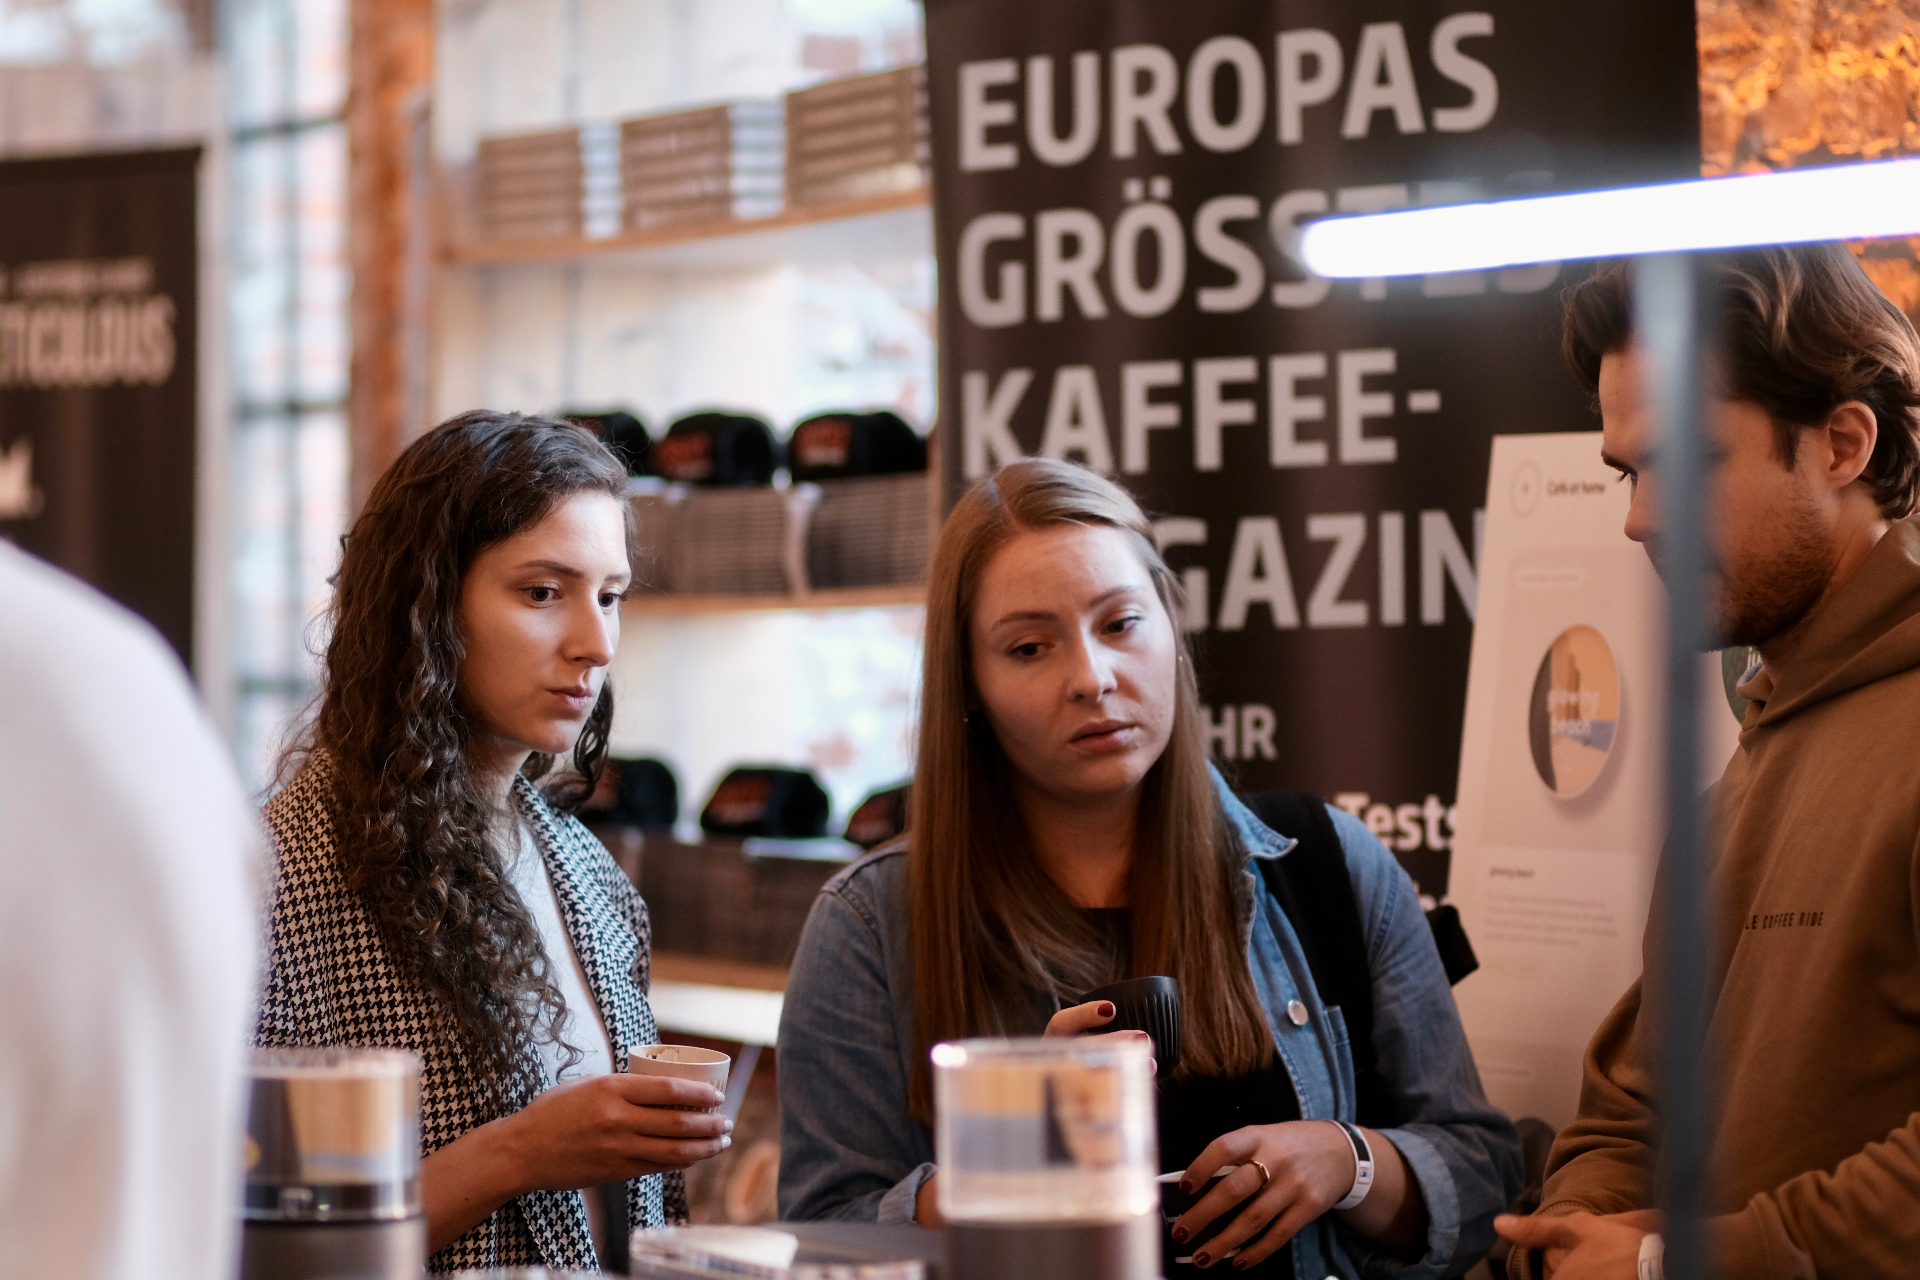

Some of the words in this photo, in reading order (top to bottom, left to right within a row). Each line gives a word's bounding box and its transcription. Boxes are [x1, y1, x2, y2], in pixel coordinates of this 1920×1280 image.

[958, 12, 1500, 172] EUROPAS
[961, 348, 1441, 482] KAFFEE-
[1150, 509, 1488, 631] GAZIN
[1334, 791, 1457, 851] Test
[1762, 911, 1795, 930] COFFEE
[1798, 911, 1824, 927] RIDE
